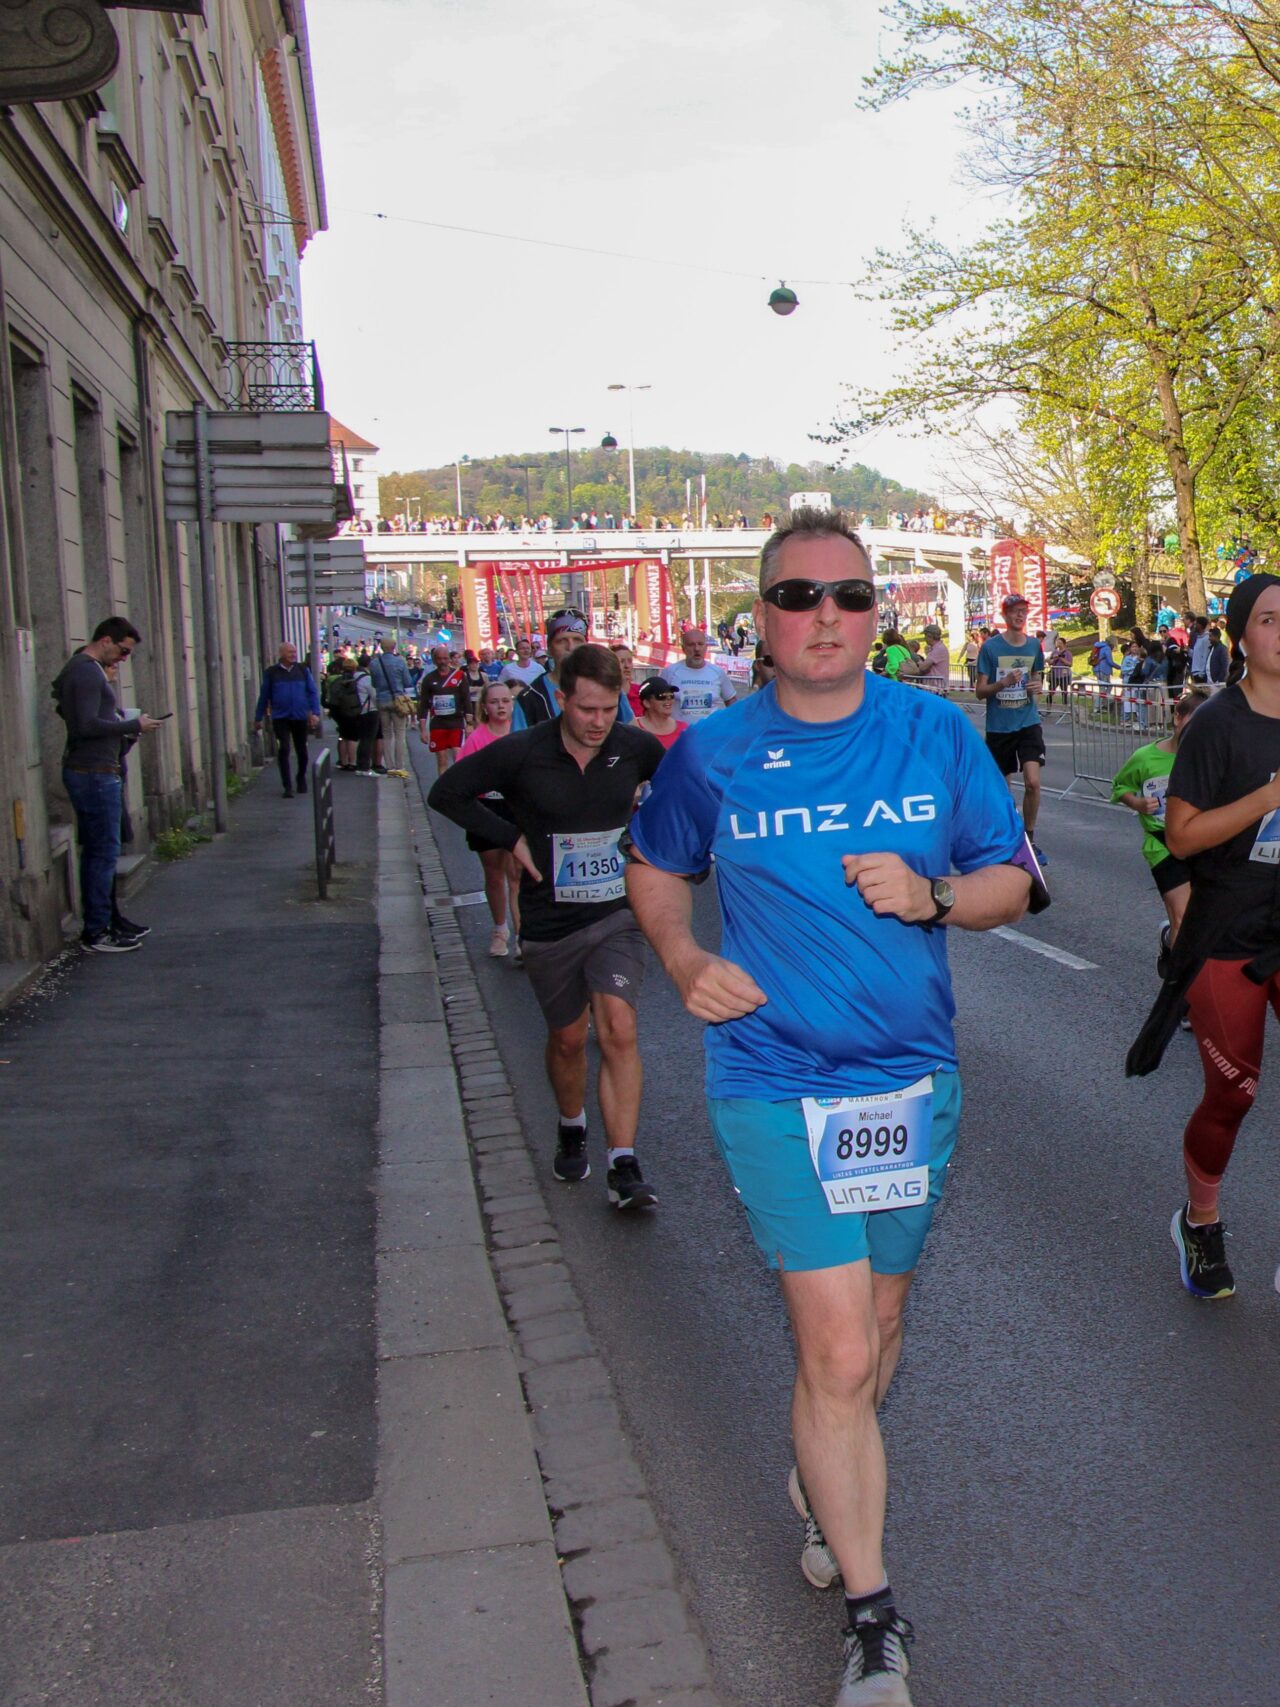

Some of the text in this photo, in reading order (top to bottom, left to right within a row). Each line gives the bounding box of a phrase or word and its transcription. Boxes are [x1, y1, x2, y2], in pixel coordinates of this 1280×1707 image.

[473, 577, 491, 638] GENERALI
[647, 564, 661, 623] GENERALI
[763, 759, 791, 769] erima
[730, 794, 935, 840] LINZ AG
[566, 857, 620, 877] 11350
[560, 884, 623, 899] LINZ AG
[1202, 1038, 1240, 1080] PUMA
[859, 1111, 893, 1121] Michael
[836, 1124, 908, 1160] 8999
[830, 1180, 921, 1205] LINZ AG
